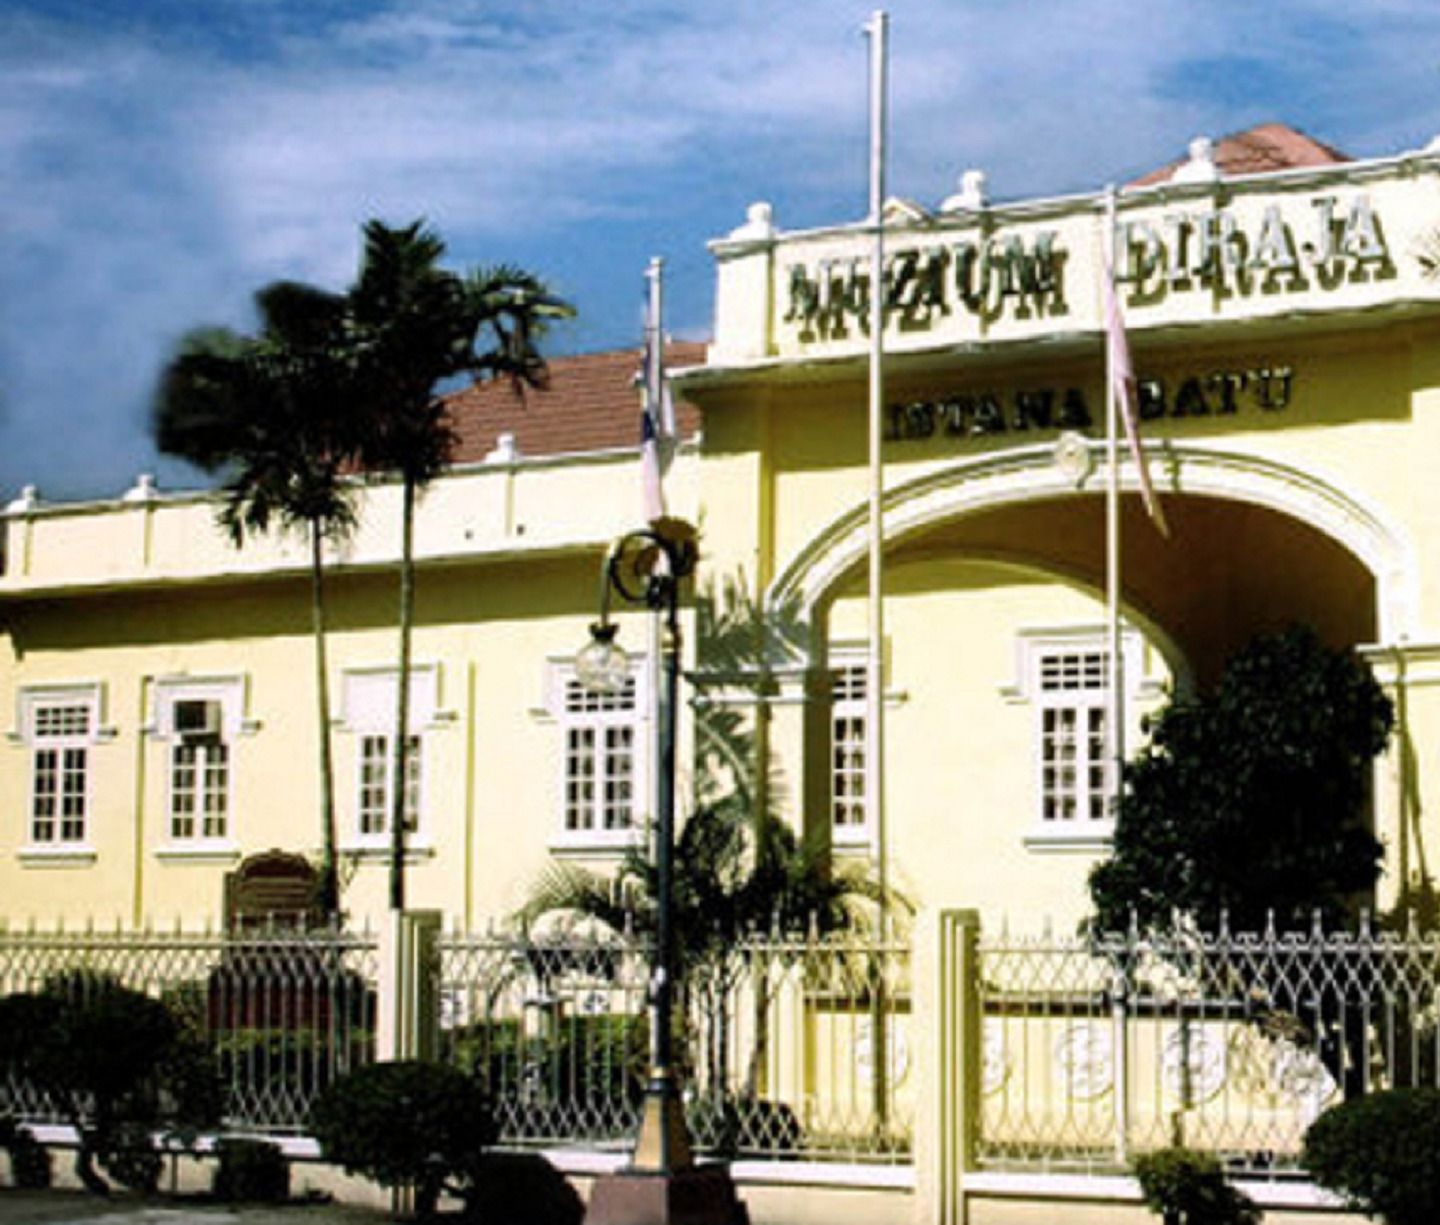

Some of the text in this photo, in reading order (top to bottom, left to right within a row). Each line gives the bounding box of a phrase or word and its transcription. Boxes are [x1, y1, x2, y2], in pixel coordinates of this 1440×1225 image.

[784, 194, 1396, 339] MUZIUM DIRAJA
[882, 366, 1293, 441] ISTANA BATU
